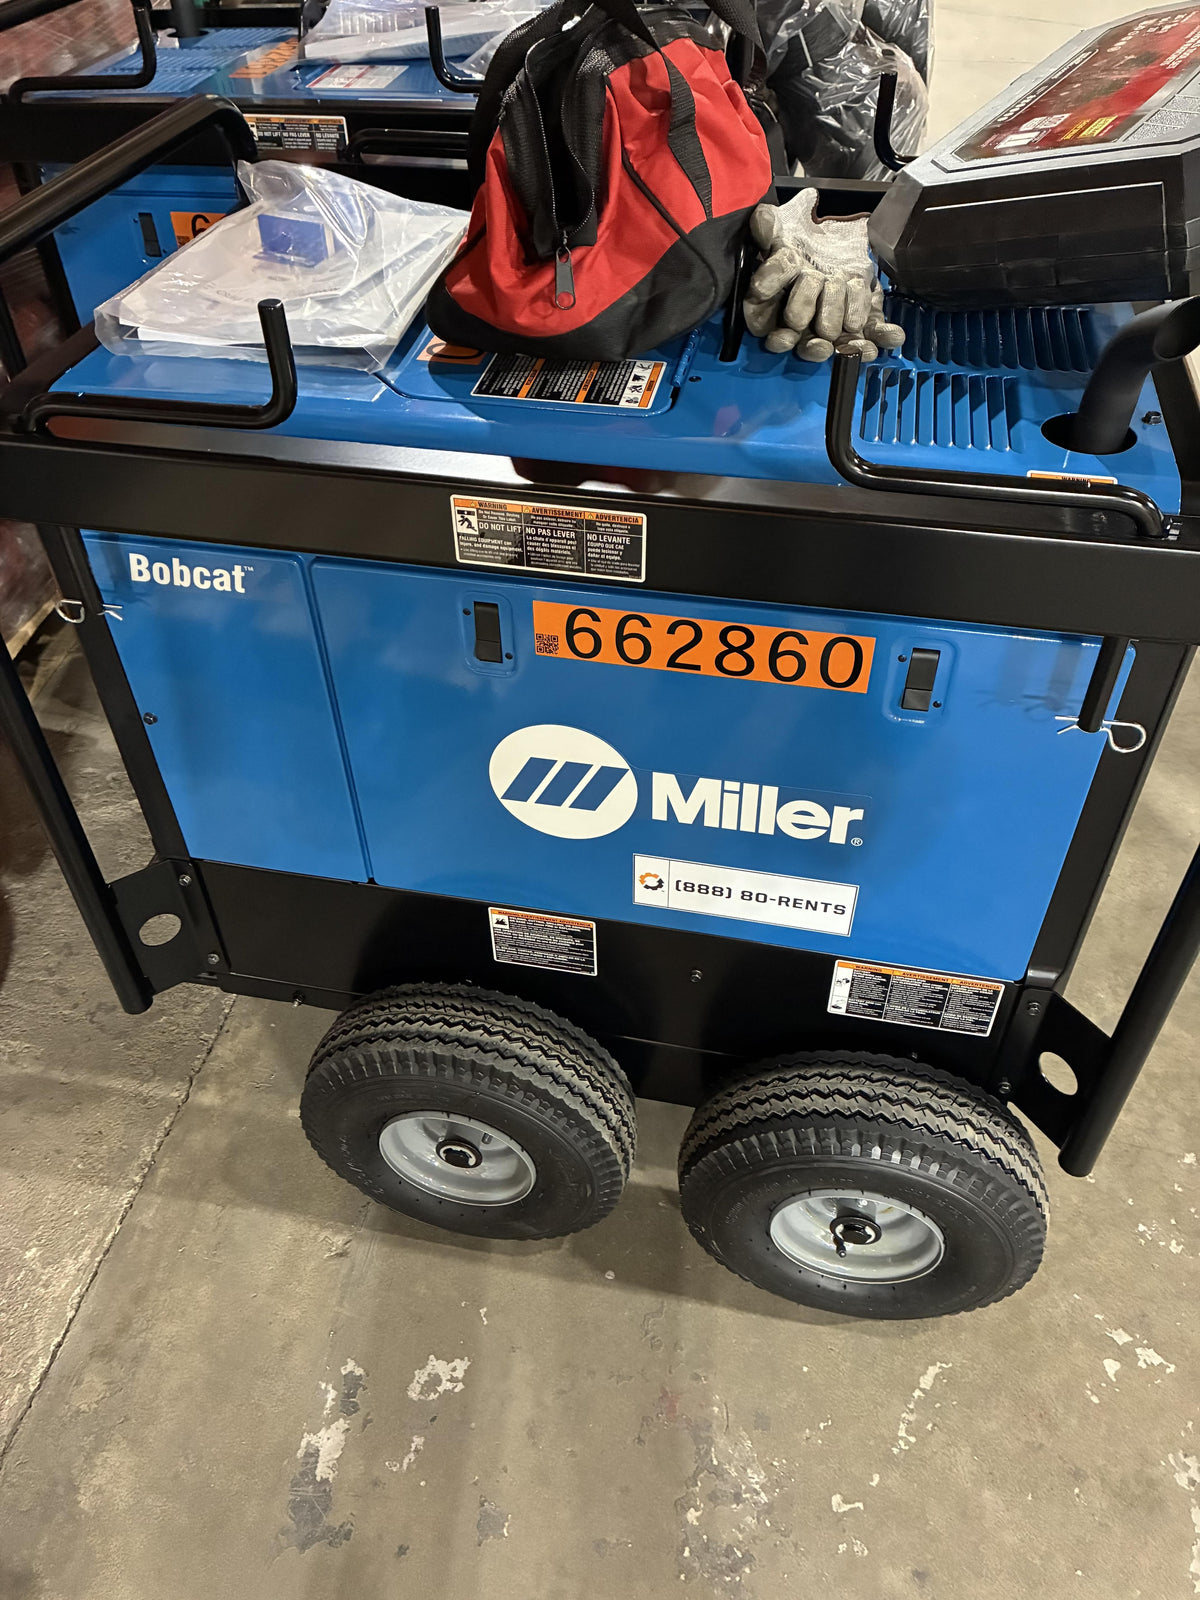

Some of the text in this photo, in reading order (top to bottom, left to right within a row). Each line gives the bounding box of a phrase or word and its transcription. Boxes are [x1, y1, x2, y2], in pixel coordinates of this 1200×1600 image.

[477, 500, 508, 510] WARNING
[531, 507, 583, 518] AVERTISSEMENT
[595, 512, 639, 523] ADVERTENCIA
[478, 522, 522, 533] DO NOT LIFT
[525, 526, 576, 539] NO PAS LEVER
[478, 537, 503, 545] EQUIPMENT
[587, 533, 631, 545] NO LEVANTE
[564, 608, 864, 689] 662860
[675, 879, 847, 915] (888) 80-RENTS
[902, 972, 949, 982] AVERTISSEMENT
